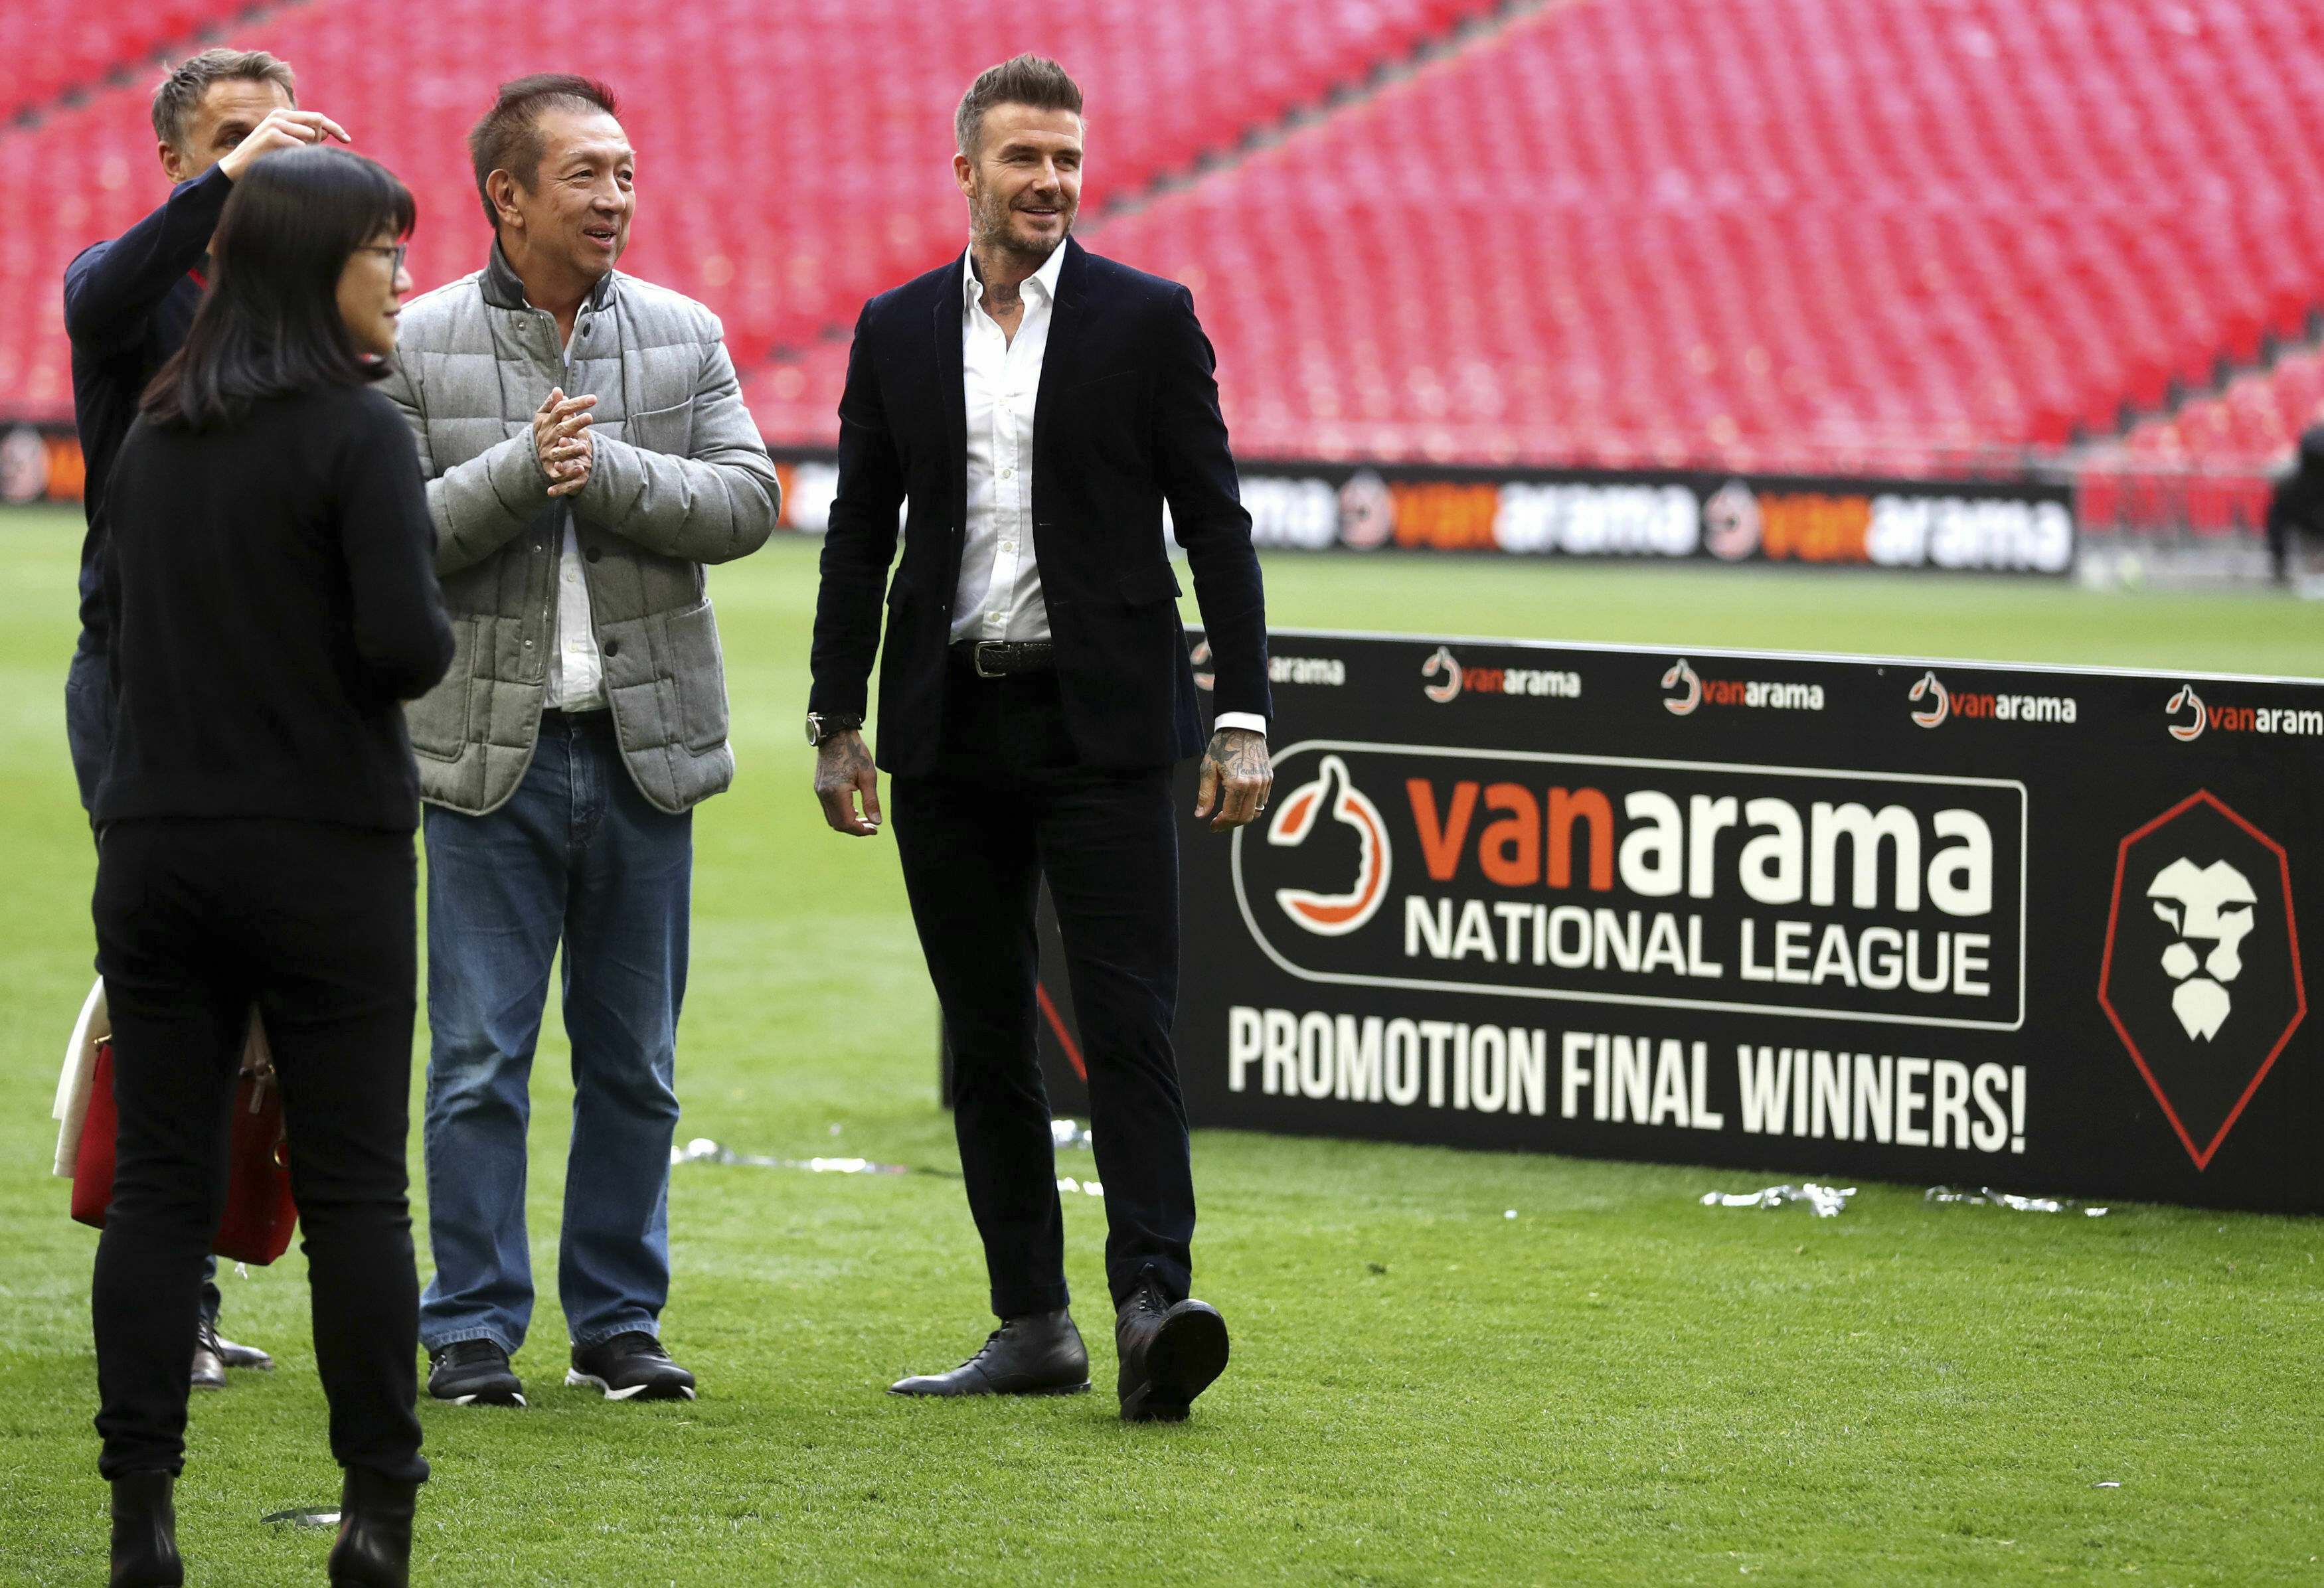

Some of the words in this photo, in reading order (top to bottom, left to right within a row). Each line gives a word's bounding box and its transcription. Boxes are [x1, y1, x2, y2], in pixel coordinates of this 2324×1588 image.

[1268, 656, 1345, 686] arama
[1462, 668, 1582, 698] vanarama
[1701, 680, 1825, 710] vanarama
[1950, 692, 2077, 724] vanarama
[2206, 706, 2324, 736] vanaram
[1406, 778, 1993, 917] vanarama
[1404, 894, 1723, 978] NATIONAL
[1740, 917, 1991, 996] LEAGUE
[1228, 1005, 1546, 1115] PROMOTION
[1562, 1031, 1724, 1130] FINAL
[1737, 1044, 2027, 1154] WINNERS!
